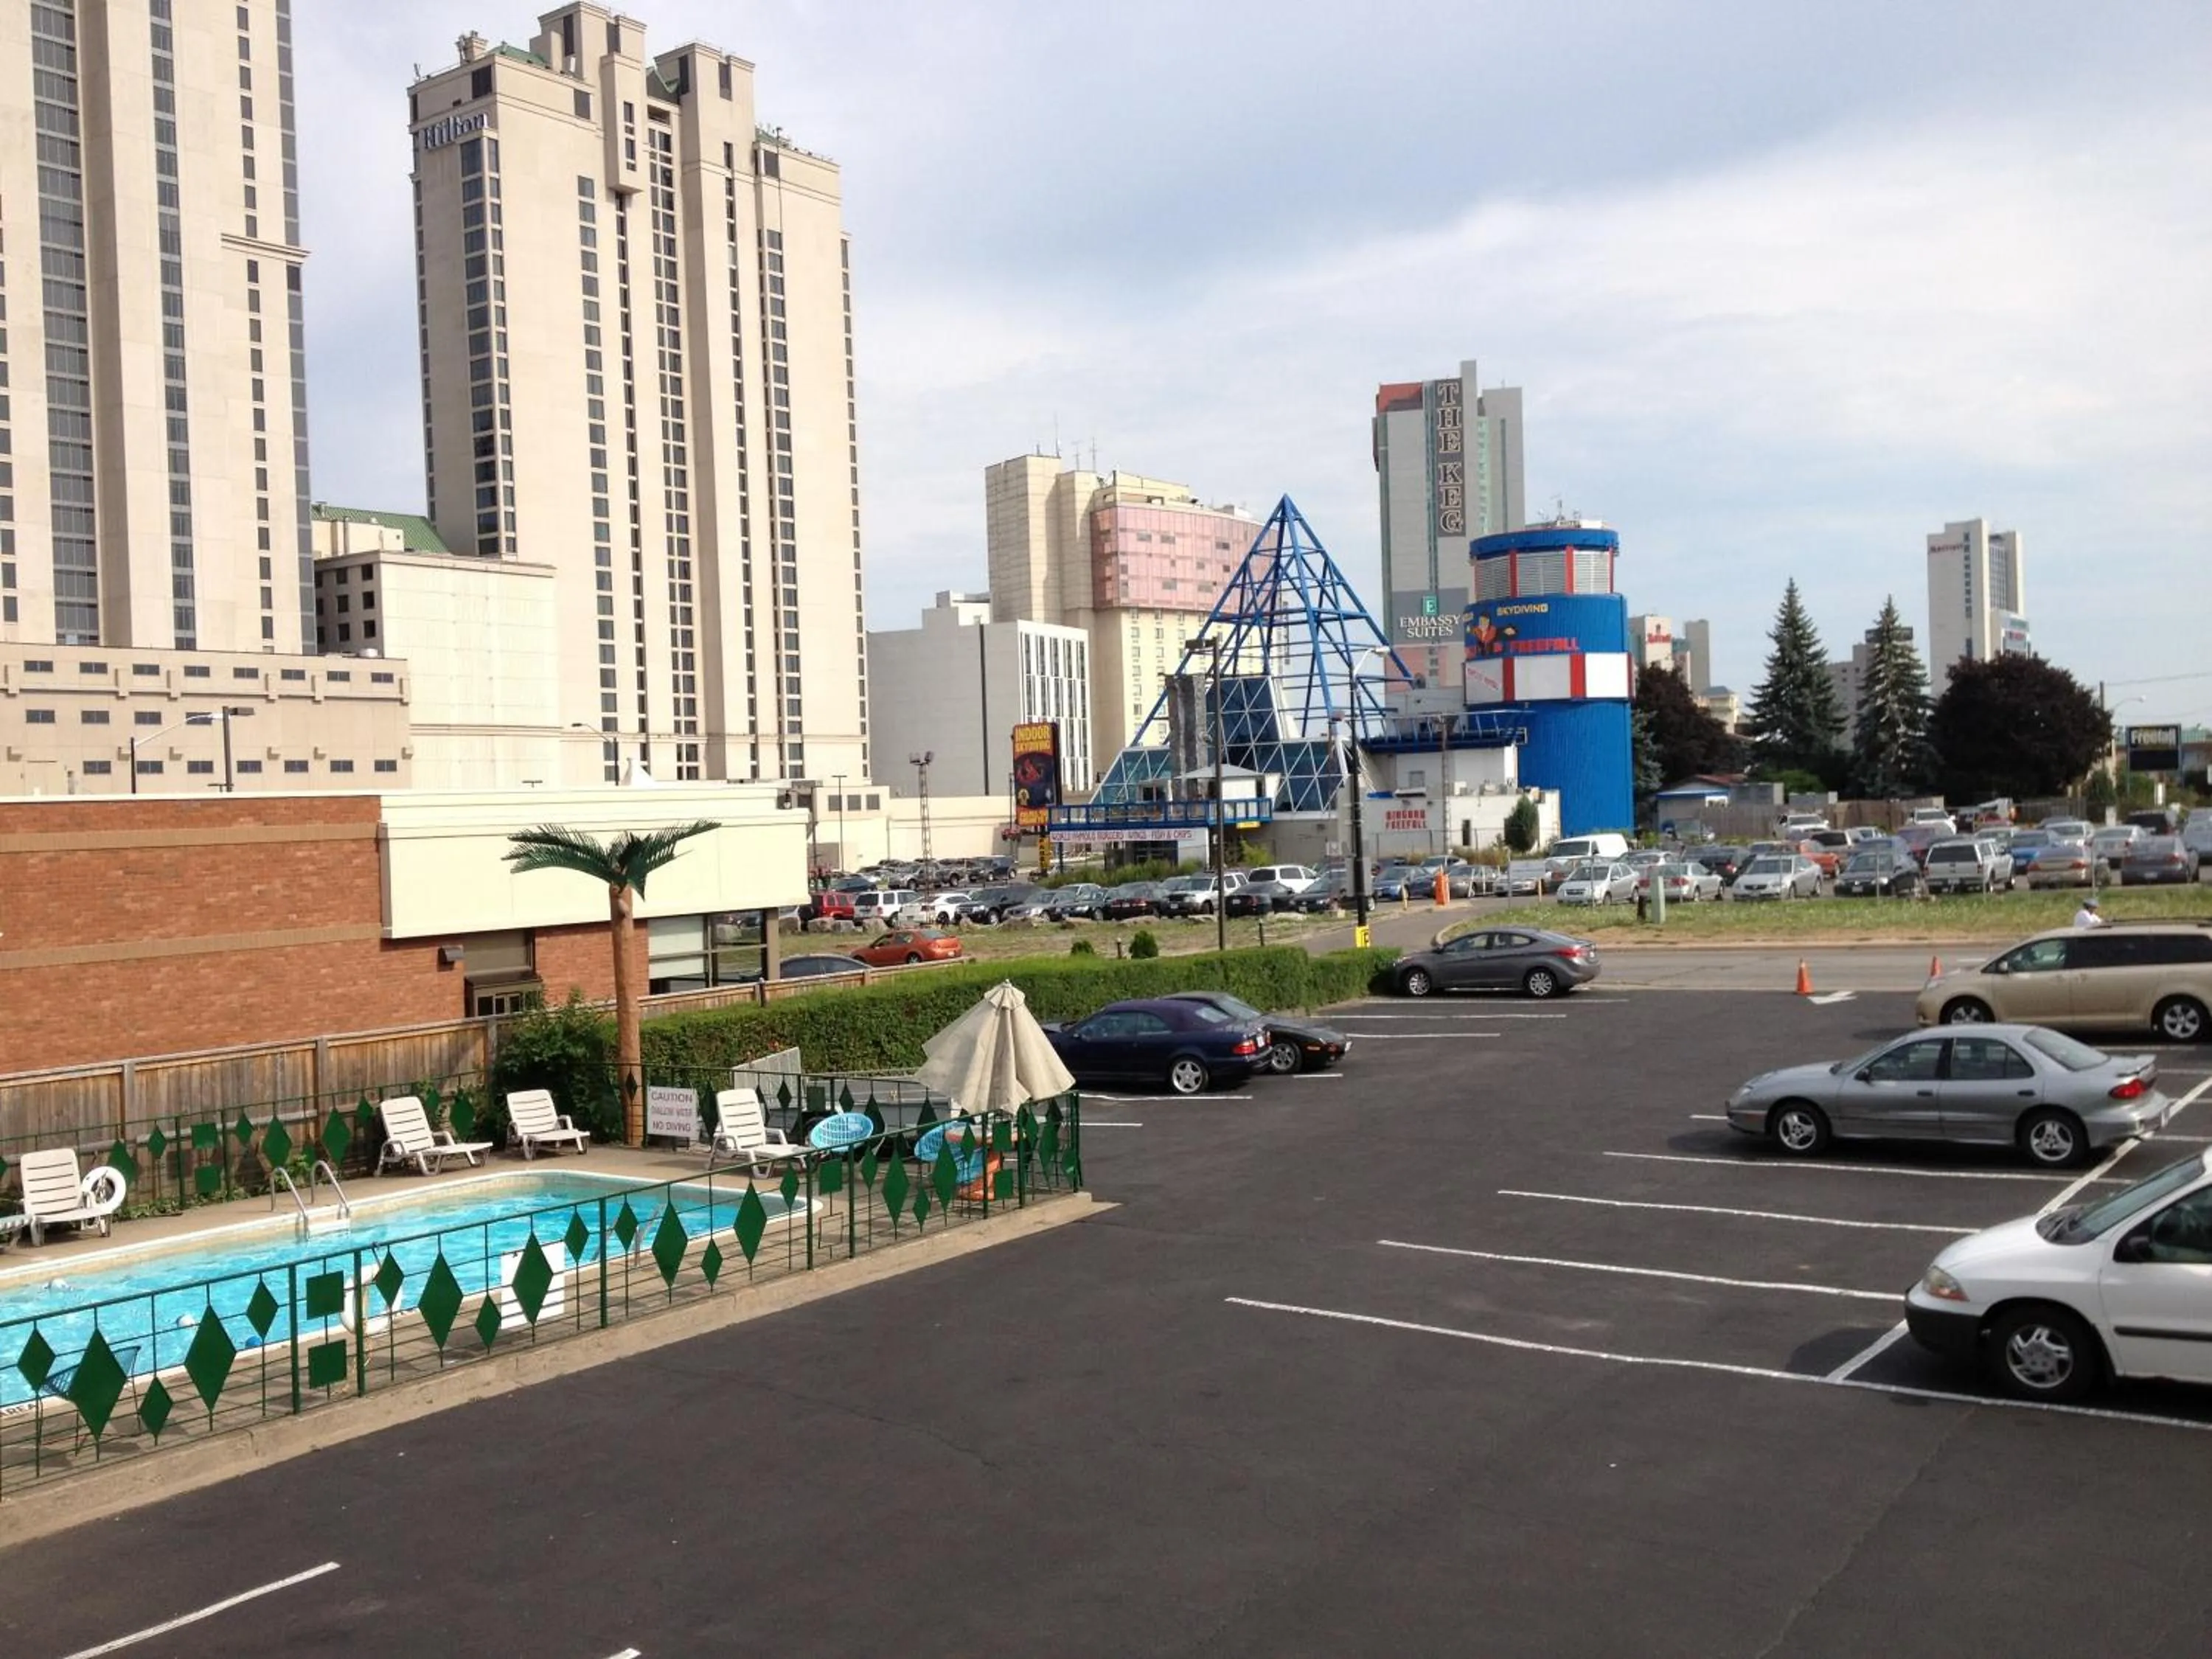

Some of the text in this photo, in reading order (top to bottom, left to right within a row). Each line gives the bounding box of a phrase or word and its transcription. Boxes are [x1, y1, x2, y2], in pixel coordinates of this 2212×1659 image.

[424, 112, 488, 149] Hilton
[1438, 383, 1464, 533] THE KEG
[1497, 603, 1548, 616] SKYDIVING
[1399, 614, 1461, 627] EMBASSY
[1406, 626, 1453, 638] SUITES
[1015, 726, 1051, 742] INDOOR
[1386, 810, 1425, 819] NIAGARA
[1386, 819, 1427, 830] FREEFALL
[651, 1091, 693, 1104] CAUTION
[653, 1120, 691, 1132] NO DIVING
